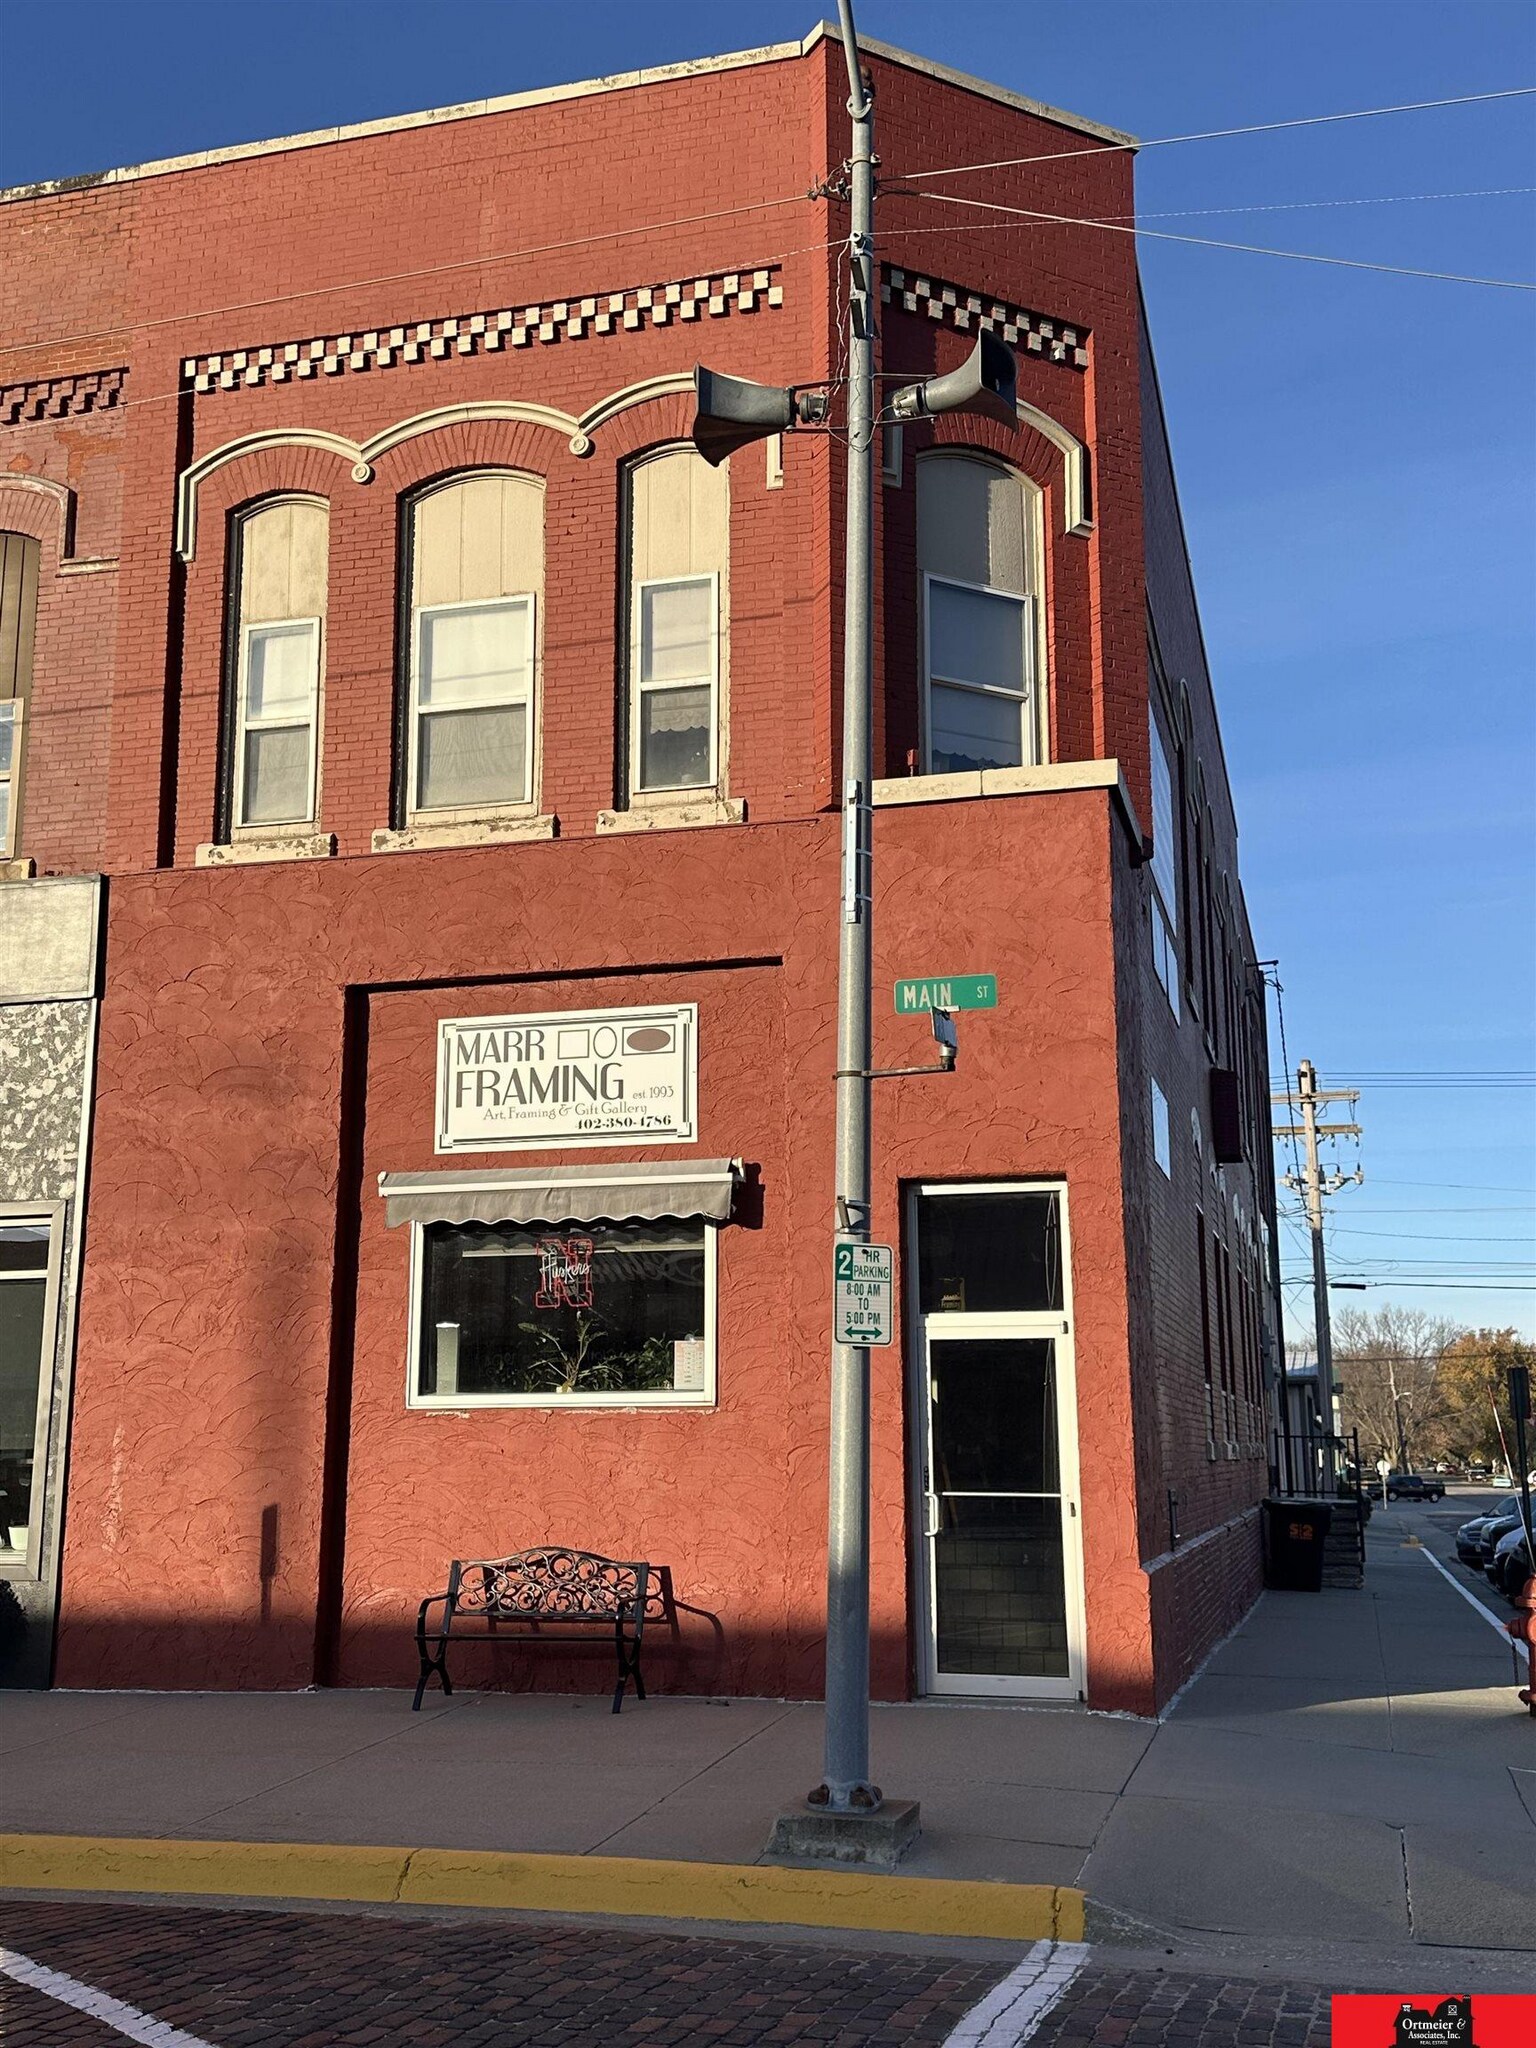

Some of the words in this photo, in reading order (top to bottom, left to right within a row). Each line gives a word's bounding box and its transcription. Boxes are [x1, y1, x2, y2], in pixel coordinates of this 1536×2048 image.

[903, 983, 952, 1009] MAIN
[976, 985, 988, 999] ST
[457, 1029, 545, 1066] MARR
[455, 1062, 624, 1108] FRAMING
[649, 1085, 675, 1099] 1993
[508, 1101, 557, 1120] Framing
[558, 1103, 573, 1117] &
[574, 1102, 599, 1116] Gift
[601, 1100, 648, 1115] Gallery
[575, 1115, 672, 1130] 402-380-4786
[838, 1250, 851, 1275] 2
[865, 1250, 880, 1263] HR
[539, 1253, 593, 1293] Huskers
[853, 1264, 889, 1279] PARKING
[846, 1282, 865, 1296] 8:00
[867, 1283, 880, 1297] AM
[857, 1297, 870, 1311] TO
[846, 1311, 865, 1325] 5:00
[867, 1312, 880, 1325] PM
